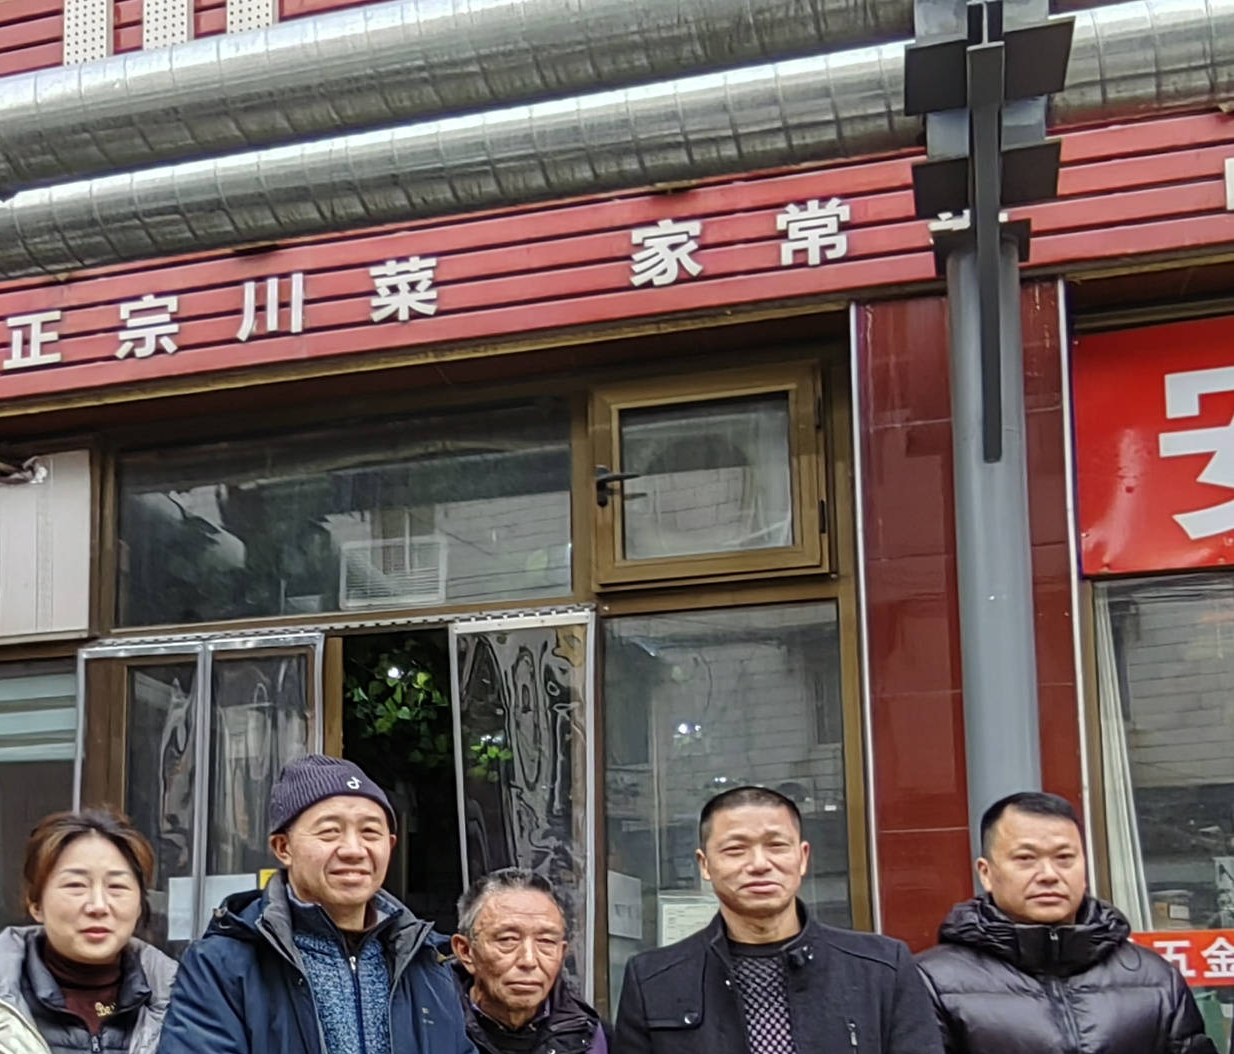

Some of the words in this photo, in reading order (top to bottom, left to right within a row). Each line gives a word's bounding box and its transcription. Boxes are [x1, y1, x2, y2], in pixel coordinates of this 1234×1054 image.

[2, 255, 439, 371] 正宗川菜
[630, 198, 1010, 287] 家常
